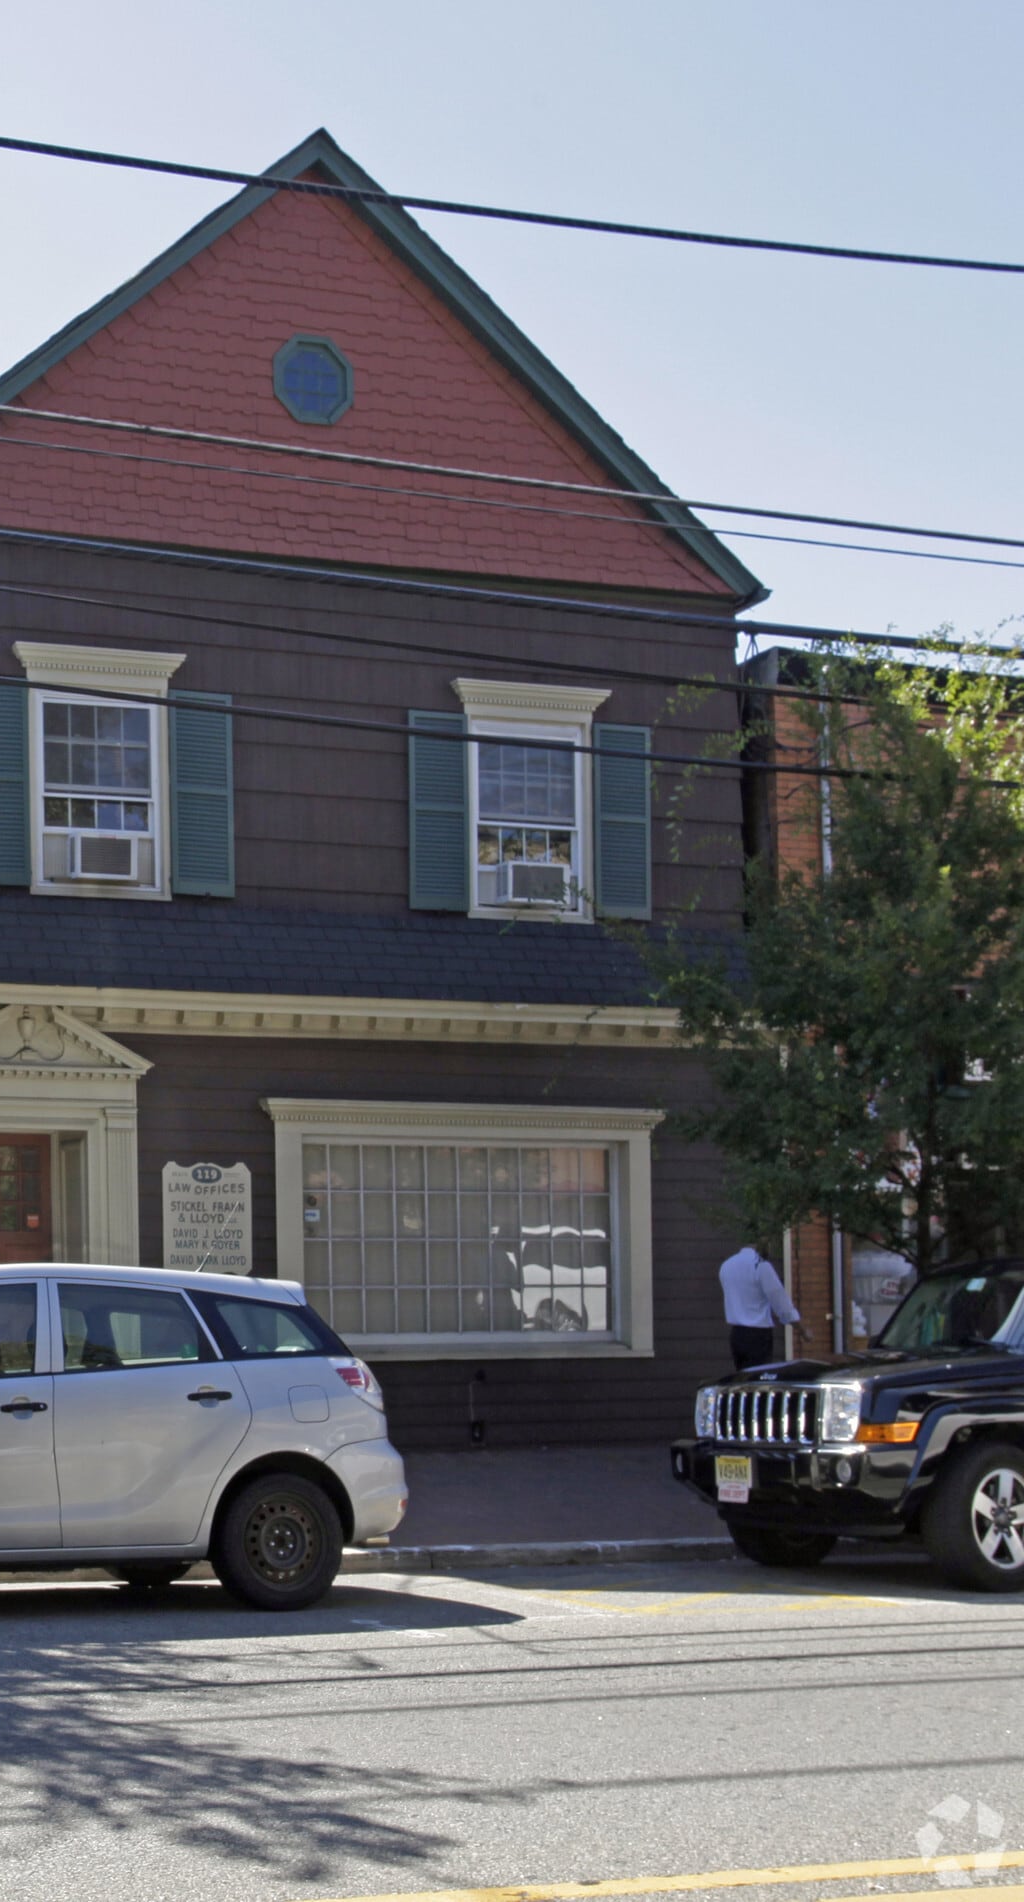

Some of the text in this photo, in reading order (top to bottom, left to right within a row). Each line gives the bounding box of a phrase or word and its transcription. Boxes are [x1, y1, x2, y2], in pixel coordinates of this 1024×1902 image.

[168, 1183, 245, 1196] LAW OFFICES
[170, 1201, 207, 1212] STICKEL
[178, 1213, 185, 1223] &
[190, 1213, 225, 1224] LLOYD
[173, 1228, 198, 1238] DAVID
[214, 1229, 243, 1240] LLOYD
[175, 1240, 199, 1249] MARY
[170, 1254, 194, 1265] DAVID
[222, 1255, 247, 1266] LLOYD
